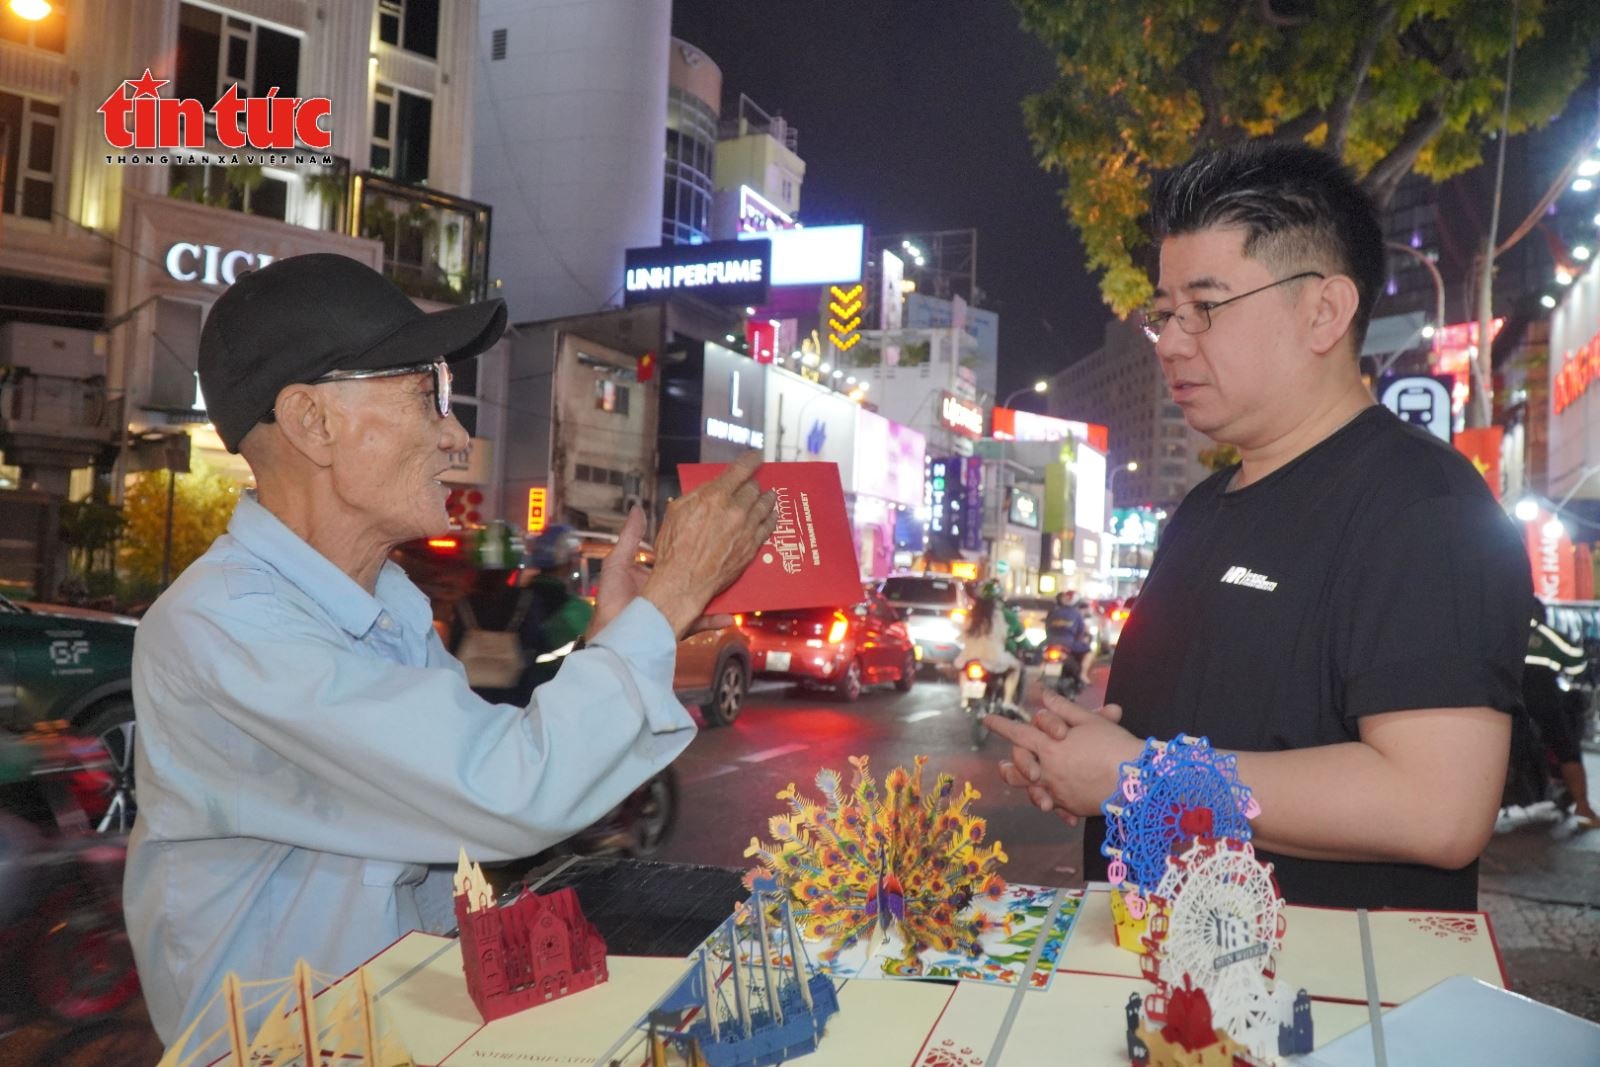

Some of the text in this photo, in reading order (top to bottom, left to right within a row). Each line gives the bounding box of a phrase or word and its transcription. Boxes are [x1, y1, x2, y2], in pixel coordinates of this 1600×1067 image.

[166, 242, 275, 285] CIC
[626, 259, 762, 291] LINH PERFUME
[800, 491, 813, 523] MARKET
[932, 463, 945, 532] HOTEL
